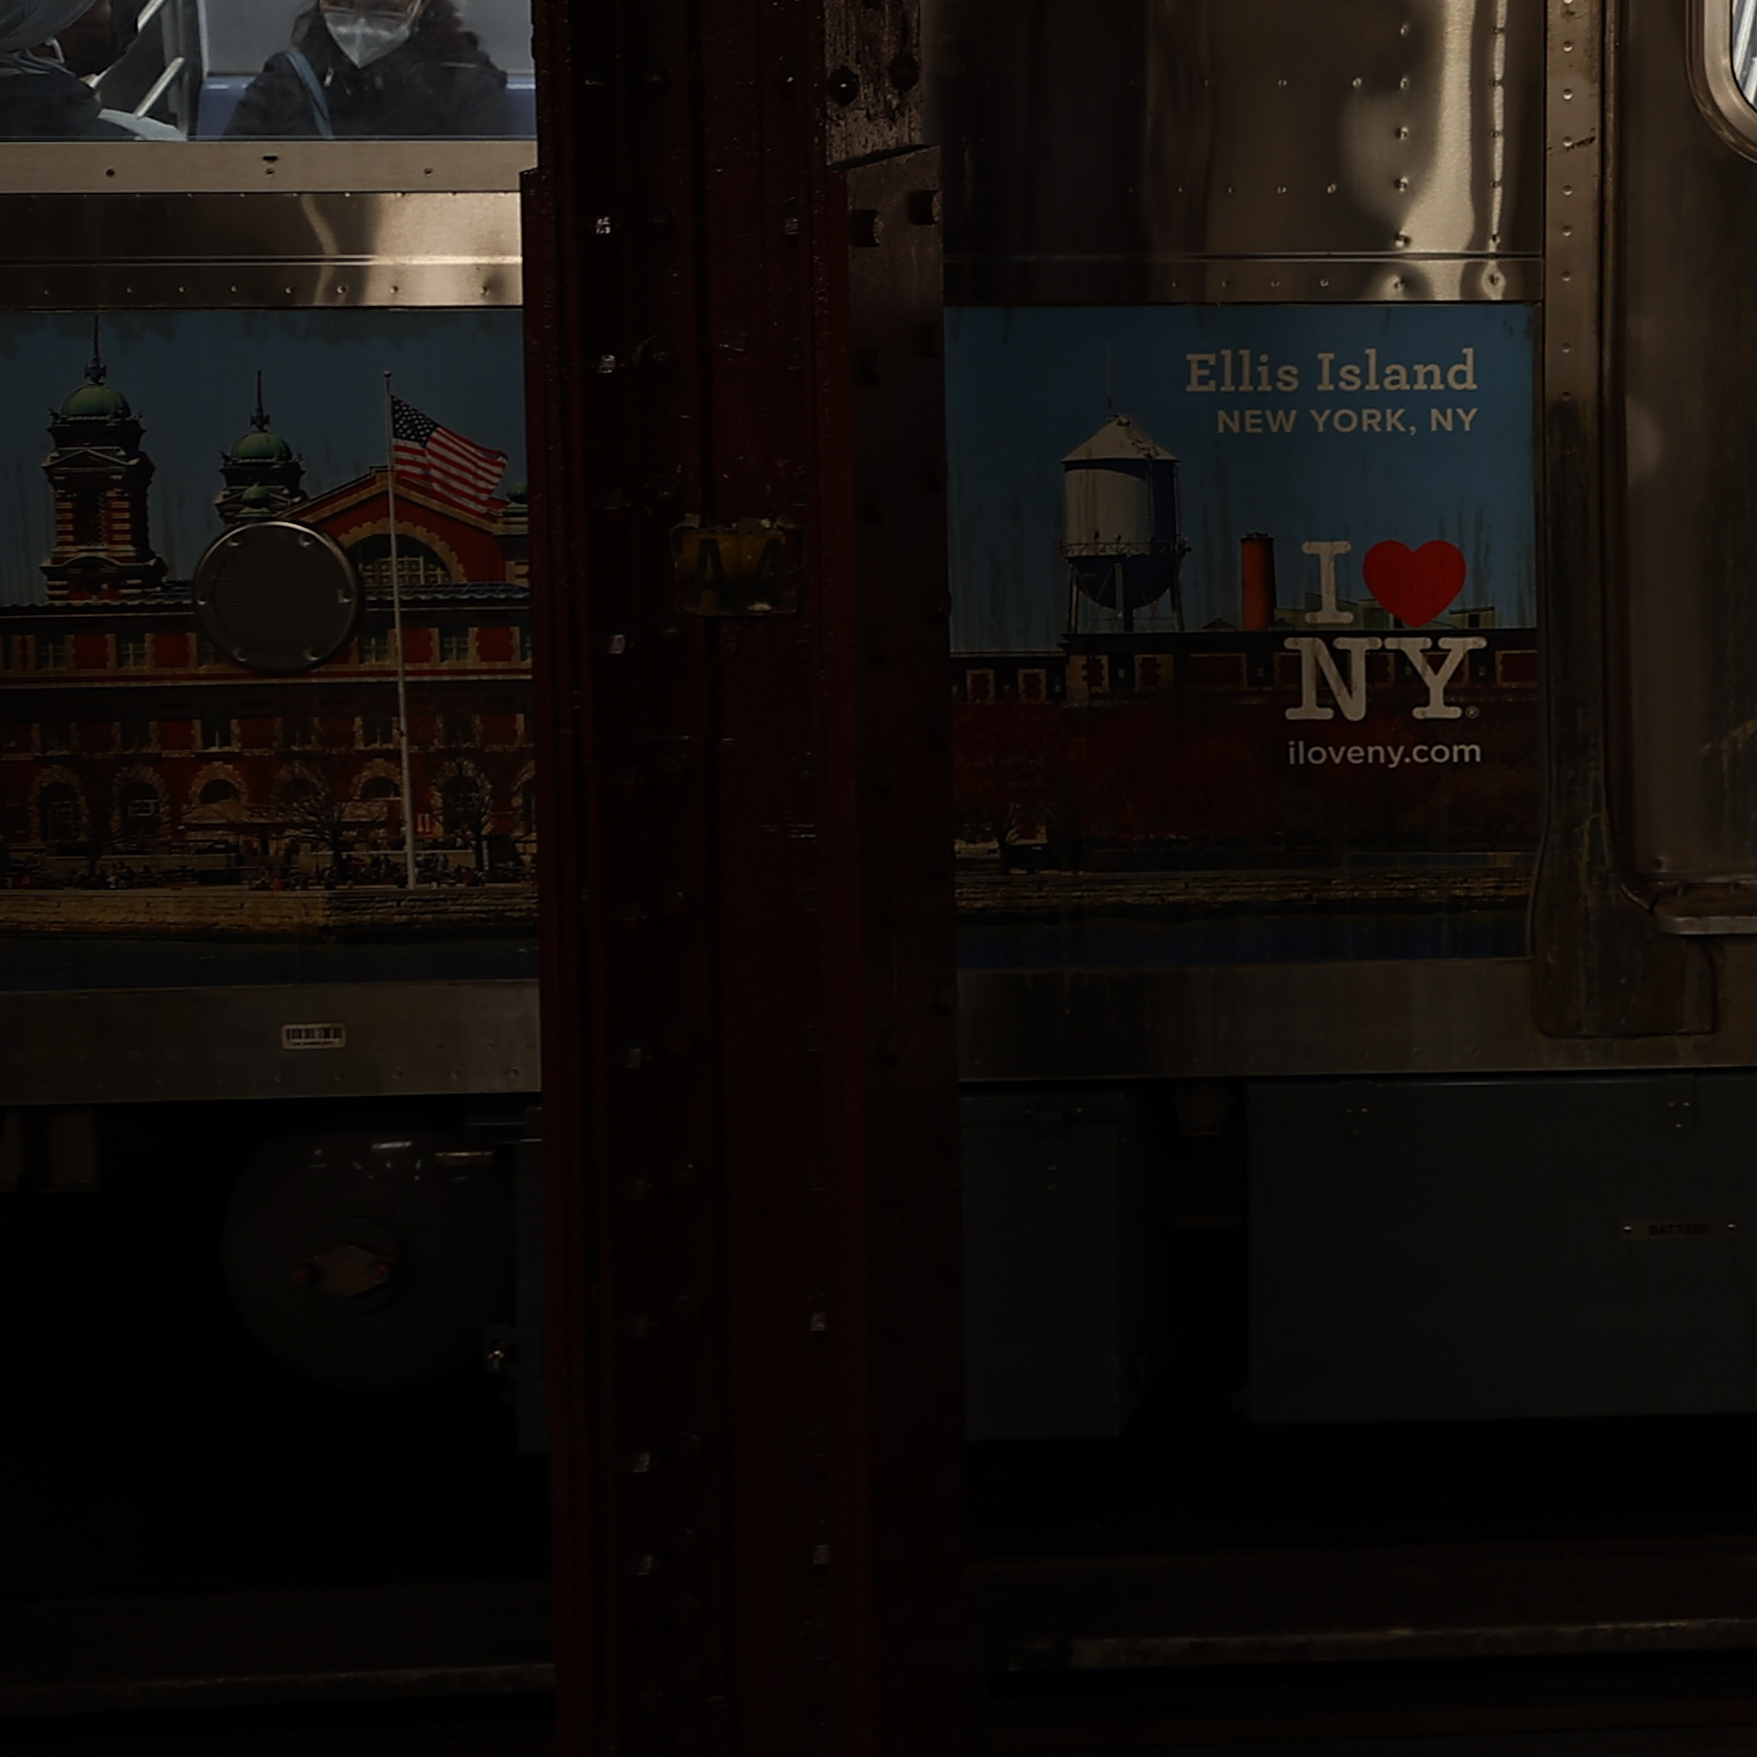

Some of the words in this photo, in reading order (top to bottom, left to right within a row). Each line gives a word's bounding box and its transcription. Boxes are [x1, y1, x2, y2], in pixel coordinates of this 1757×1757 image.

[1185, 348, 1300, 393] Ellis
[1316, 347, 1479, 391] Island
[1216, 409, 1298, 434] NEW
[1308, 407, 1418, 436] YORK,
[1429, 407, 1479, 432] NY
[1301, 540, 1354, 624] I
[1282, 636, 1488, 722] NY
[1287, 739, 1482, 769] iloveny.com
[1648, 1222, 1710, 1236] BATTERY
